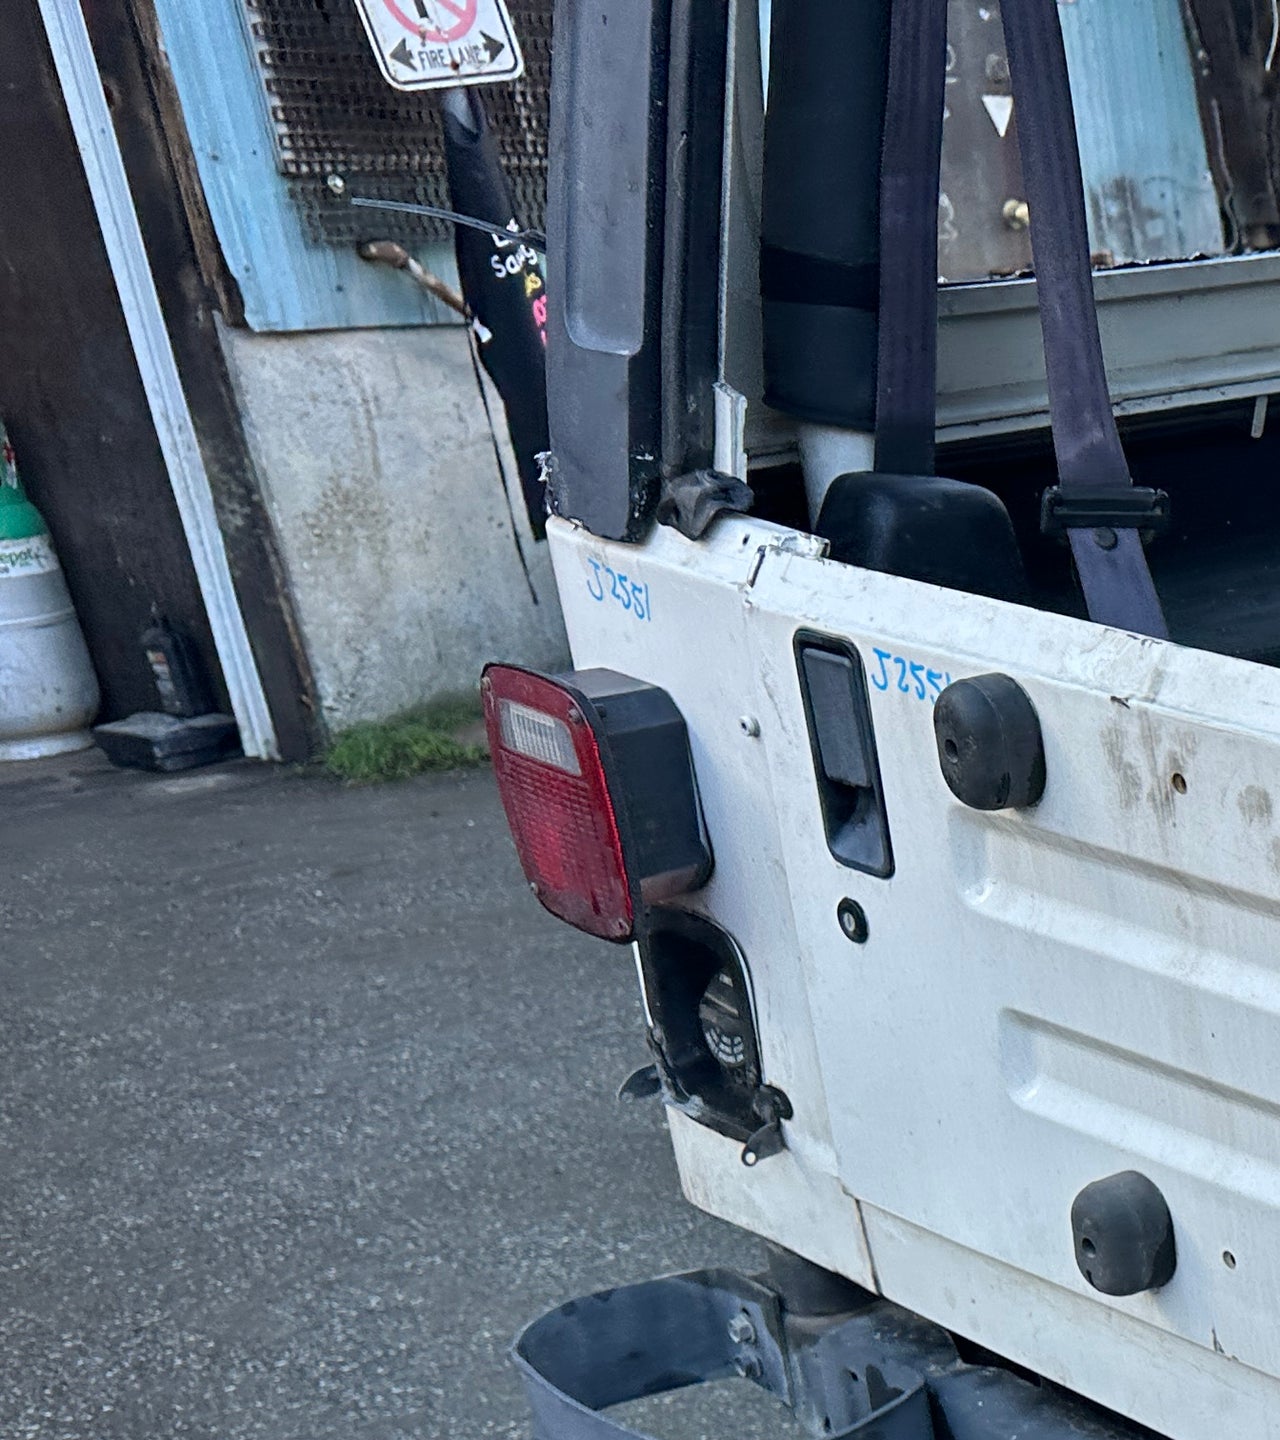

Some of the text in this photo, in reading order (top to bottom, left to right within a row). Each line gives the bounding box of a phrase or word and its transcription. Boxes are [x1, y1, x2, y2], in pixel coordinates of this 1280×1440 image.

[417, 44, 486, 71] FIRE LANE
[586, 557, 652, 622] J2551
[871, 646, 952, 706] J255
